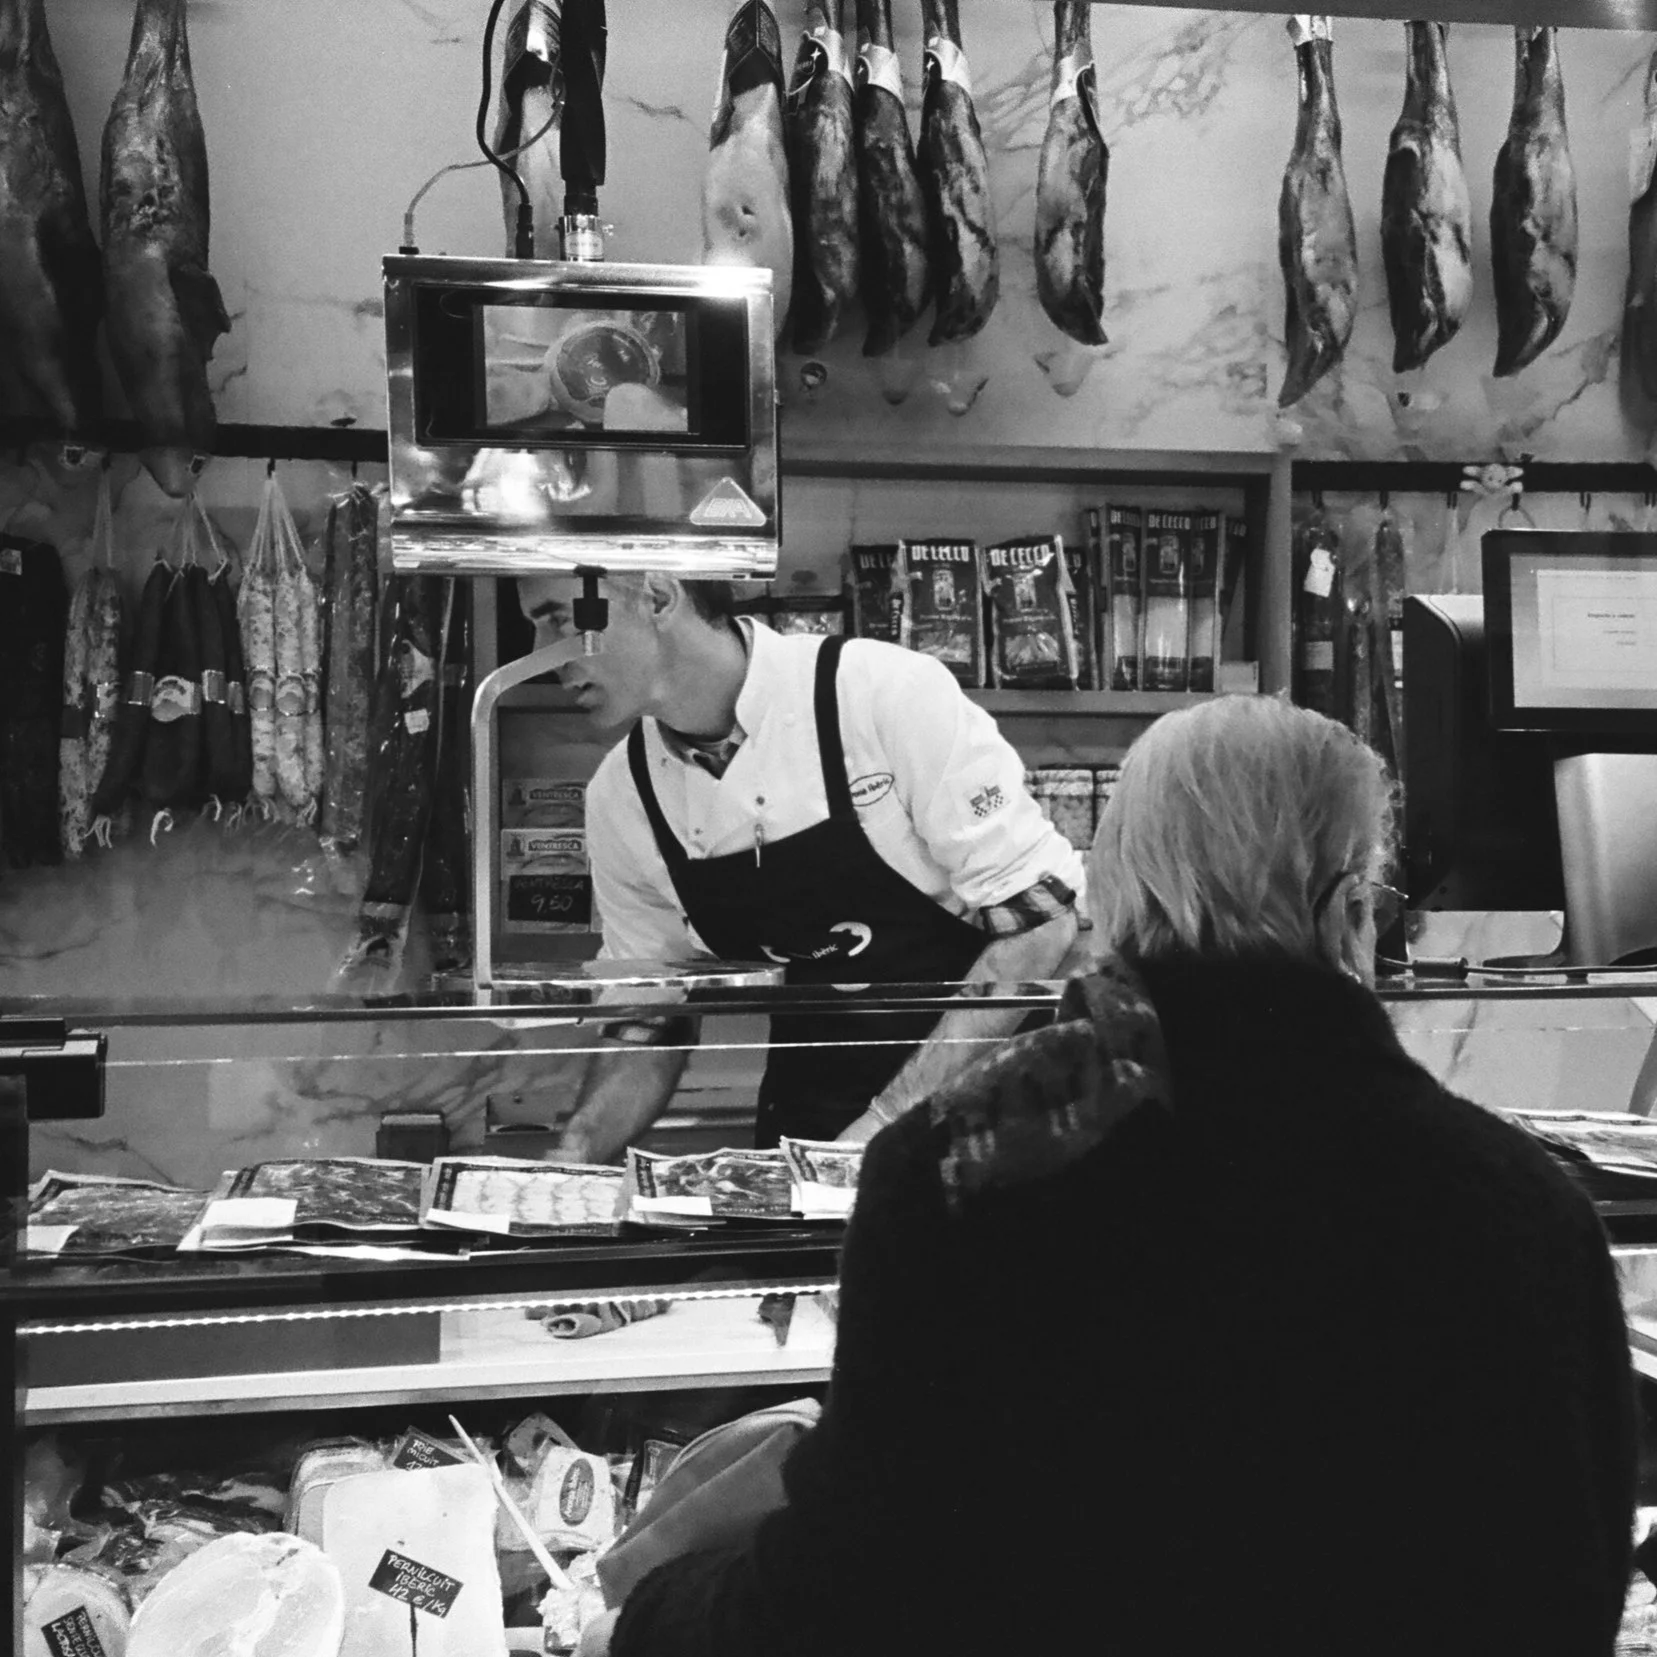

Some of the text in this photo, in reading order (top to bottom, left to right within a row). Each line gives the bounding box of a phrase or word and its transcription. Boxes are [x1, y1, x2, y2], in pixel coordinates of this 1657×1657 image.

[912, 545, 929, 561] DE
[990, 549, 1009, 566] DE
[532, 789, 580, 799] VENTRESCA
[530, 841, 580, 850] VENTRESCA
[388, 1583, 409, 1601] 42
